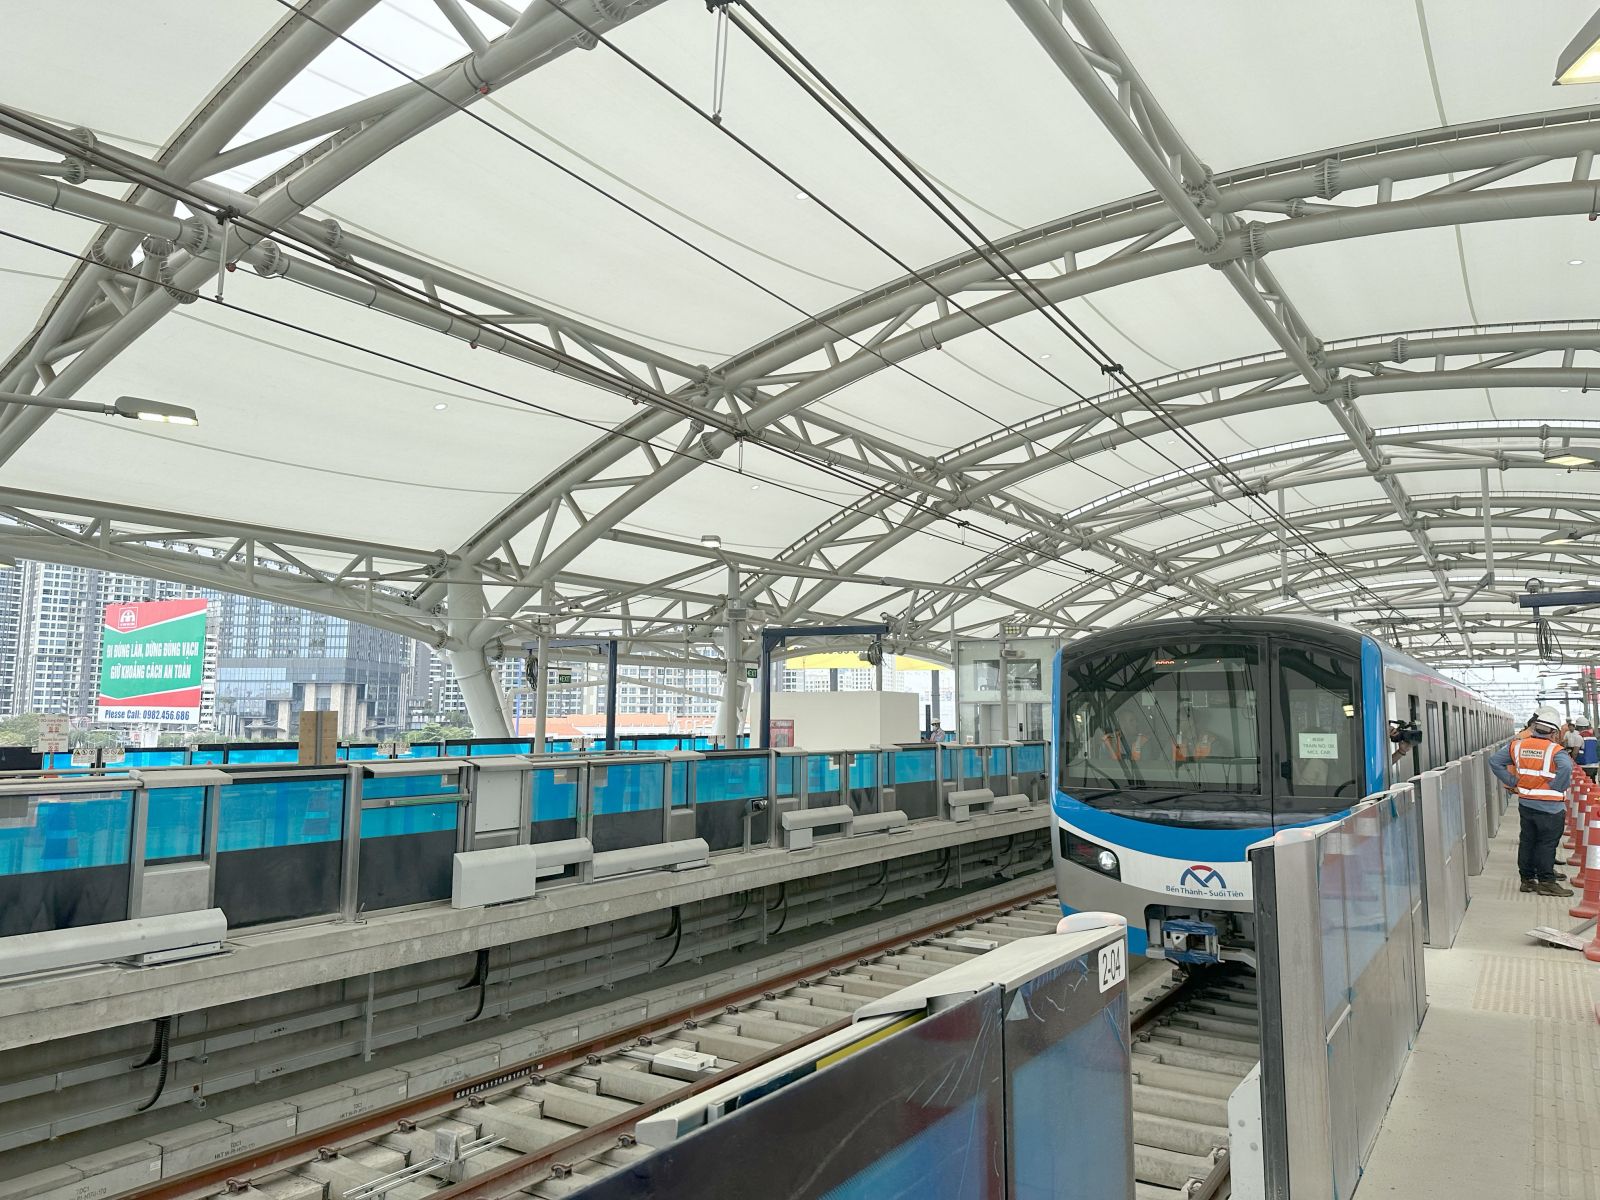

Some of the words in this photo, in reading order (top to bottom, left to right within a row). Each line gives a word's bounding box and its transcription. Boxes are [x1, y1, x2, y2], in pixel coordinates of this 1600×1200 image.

[182, 641, 199, 660] VẠCH
[121, 660, 145, 679] KHOẢNG
[146, 662, 163, 678] CÁCH
[164, 664, 174, 678] AN
[175, 661, 191, 678] TOÀN
[105, 710, 125, 719] Please
[127, 710, 141, 719] Call:
[143, 710, 190, 721] 0982.456.686
[1166, 885, 1179, 893] Bến
[1181, 887, 1203, 896] Thành
[1209, 889, 1227, 897] Suối
[1227, 889, 1244, 898] Tiên
[1102, 945, 1121, 986] 2-04
